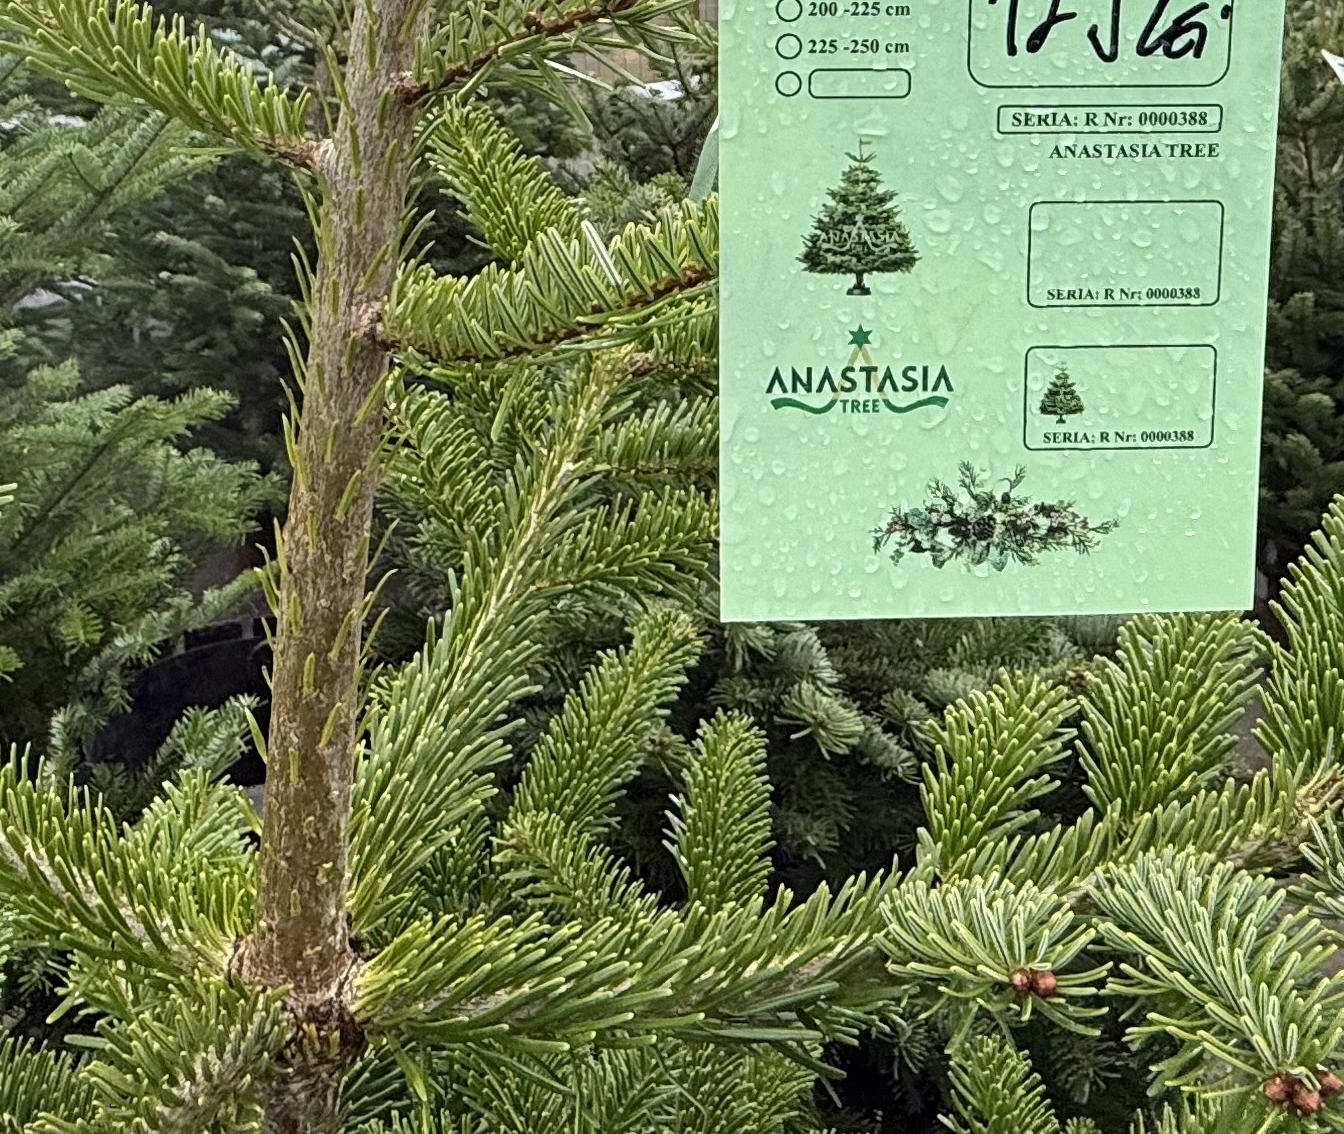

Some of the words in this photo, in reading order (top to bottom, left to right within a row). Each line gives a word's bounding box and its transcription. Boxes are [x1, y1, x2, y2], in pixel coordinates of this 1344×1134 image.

[808, 2, 838, 16] 200
[886, 6, 911, 16] cm
[808, 39, 838, 54] 225
[885, 43, 910, 54] cm
[1011, 112, 1078, 128] SERIA:
[1084, 112, 1099, 127] R
[1103, 112, 1132, 128] Nr:
[1138, 112, 1208, 127] 0000388
[1048, 143, 1164, 159] ANASTASIA
[1167, 143, 1220, 159] TREE
[1046, 288, 1100, 301] SERIA:
[1104, 288, 1116, 300] R
[1119, 288, 1142, 301] Nr:
[1146, 287, 1201, 300] 0000388
[765, 365, 955, 394] ANASTASIA
[839, 398, 881, 414] TREE
[1042, 431, 1096, 444] SERIA:
[1100, 432, 1111, 444] R
[1114, 431, 1137, 443] Nr:
[1141, 430, 1195, 443] 0000388
